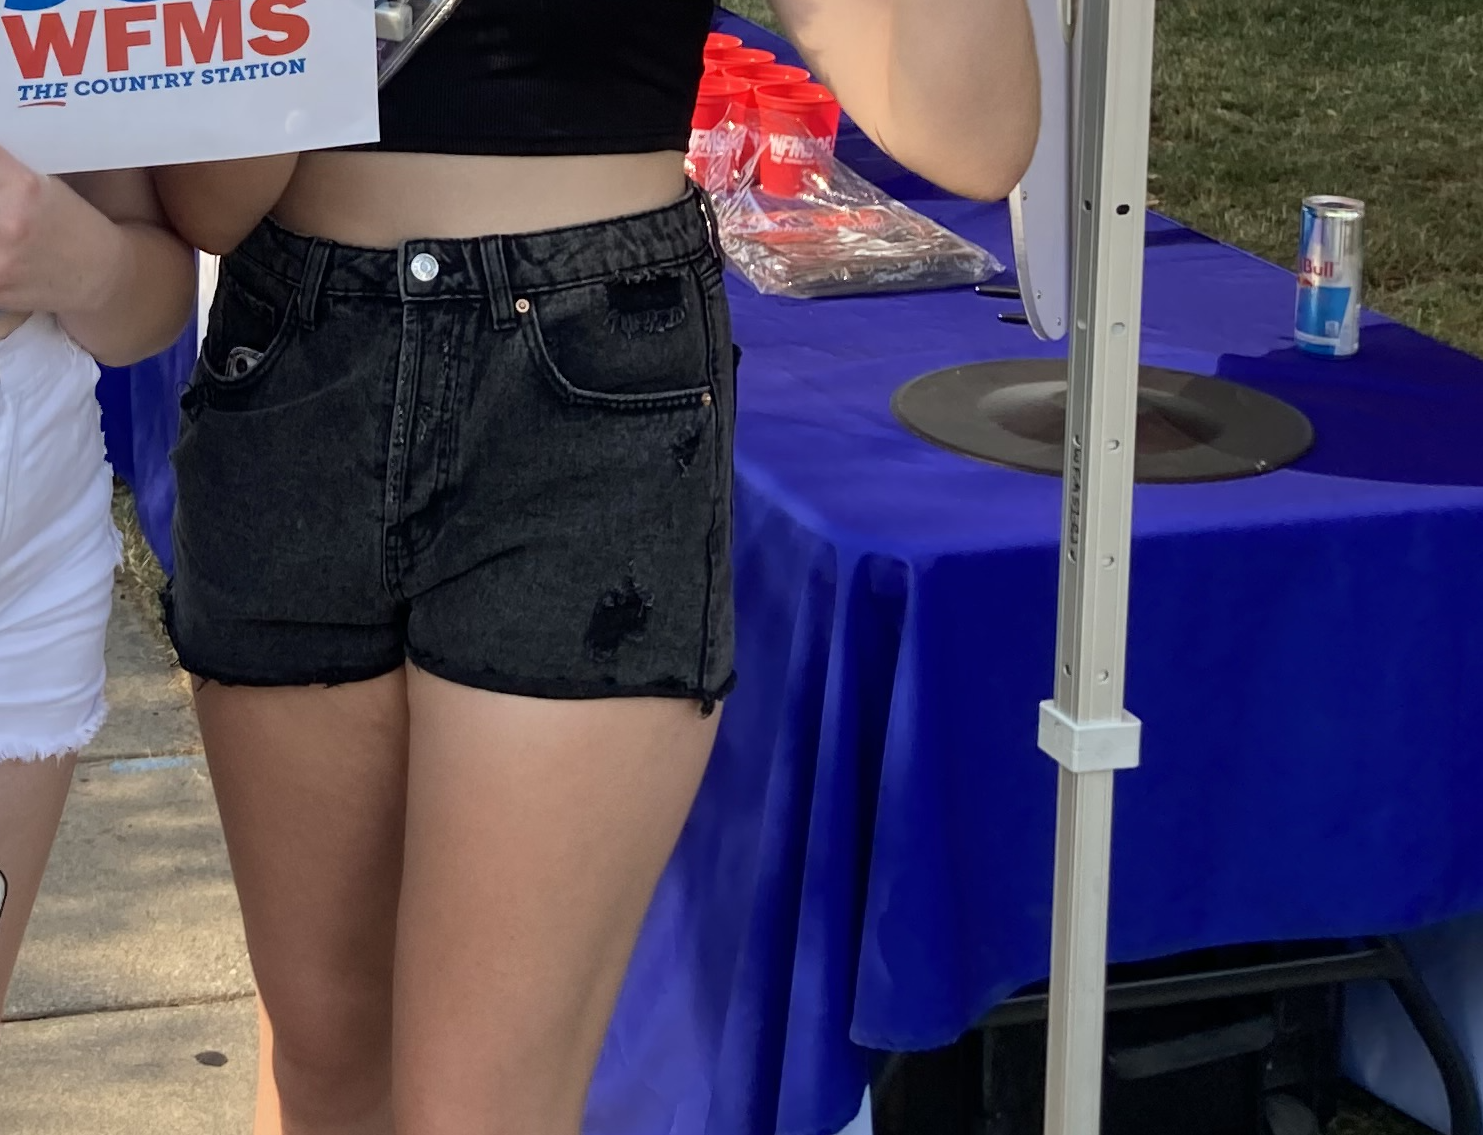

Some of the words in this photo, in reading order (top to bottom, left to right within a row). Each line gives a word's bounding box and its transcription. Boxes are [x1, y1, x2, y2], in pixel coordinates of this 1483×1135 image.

[18, 82, 67, 101] THE
[74, 70, 195, 96] COUNTRY
[201, 58, 306, 85] STATION
[1303, 258, 1333, 278] Bull
